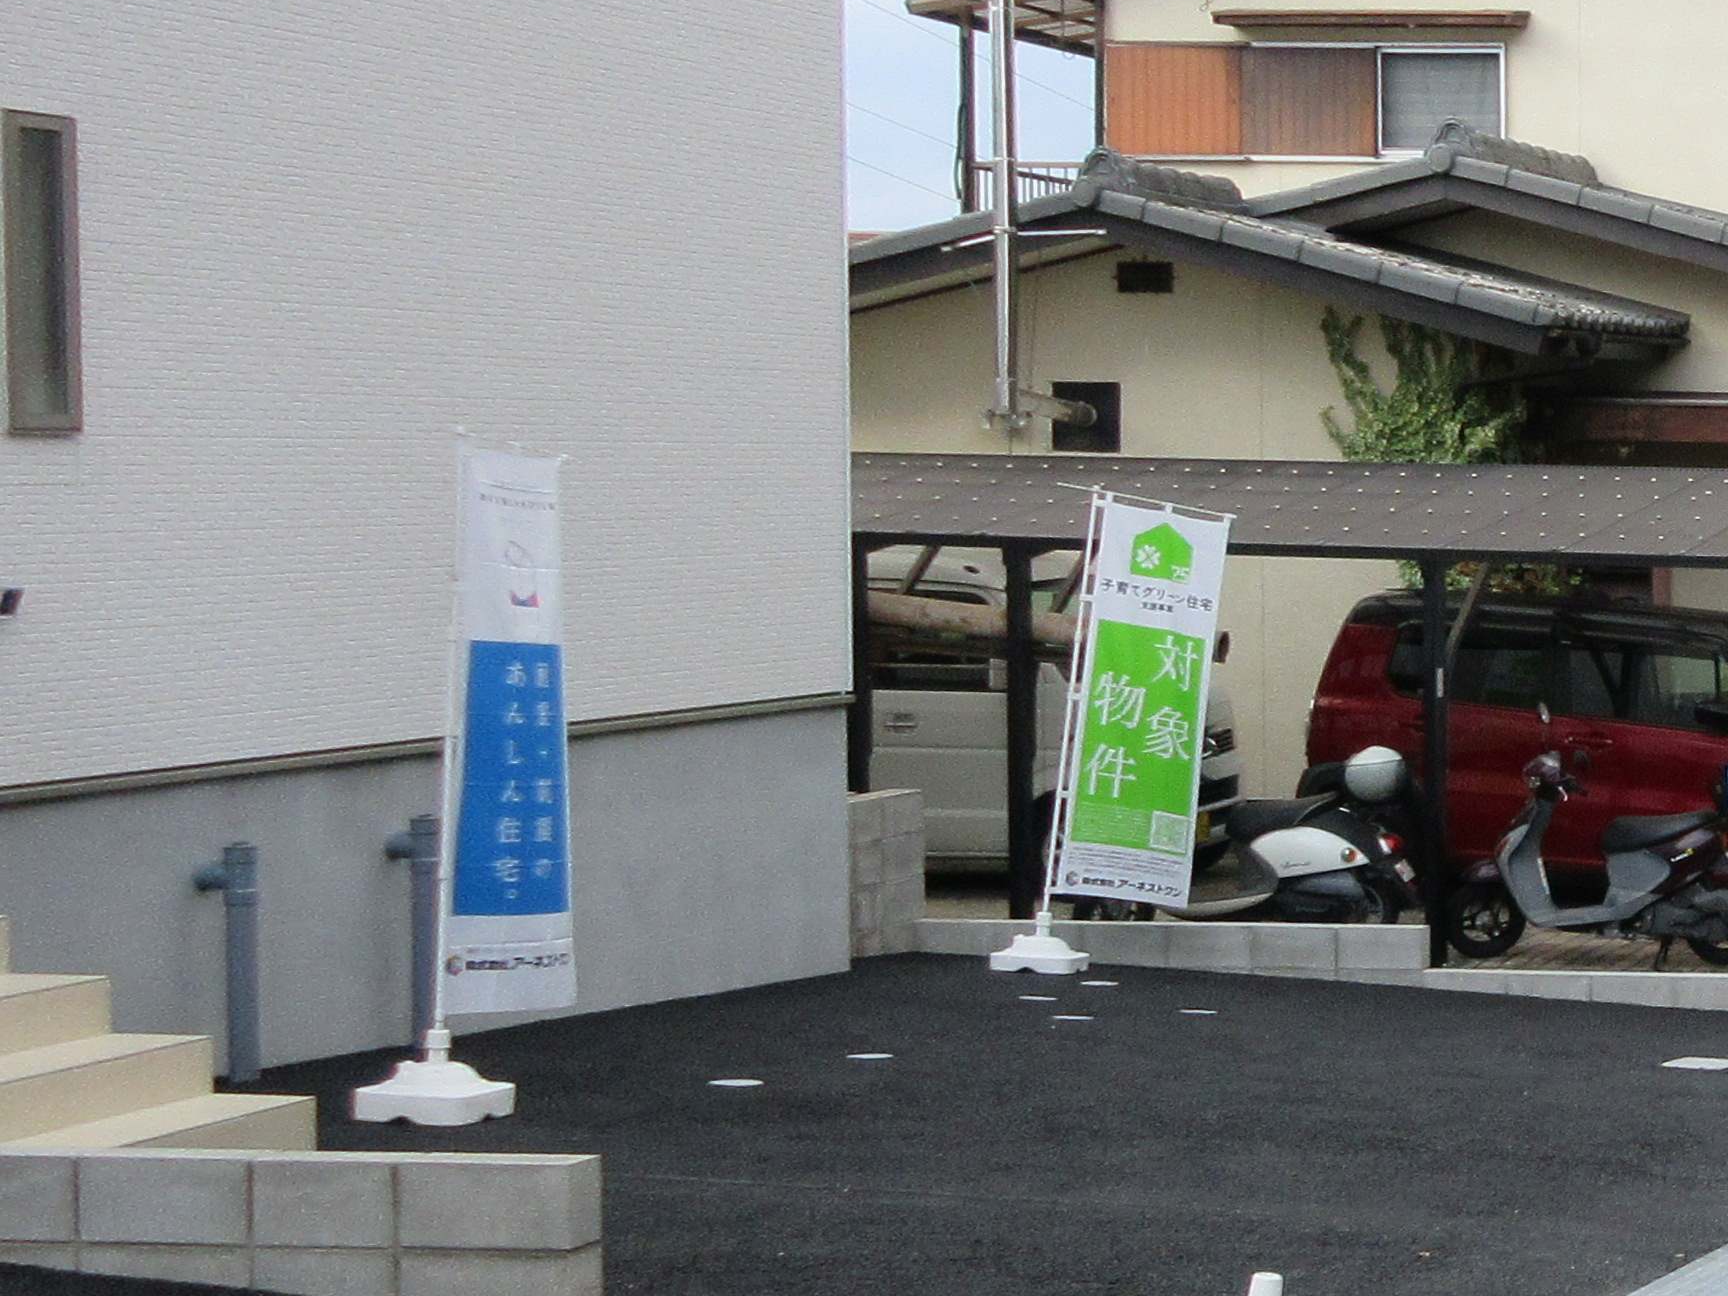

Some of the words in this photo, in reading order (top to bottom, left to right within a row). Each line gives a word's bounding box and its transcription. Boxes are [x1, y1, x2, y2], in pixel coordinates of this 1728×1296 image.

[1101, 577, 1213, 612] 子育てグリーン住宅
[1084, 670, 1147, 798] 物件
[1142, 635, 1200, 761] 対象
